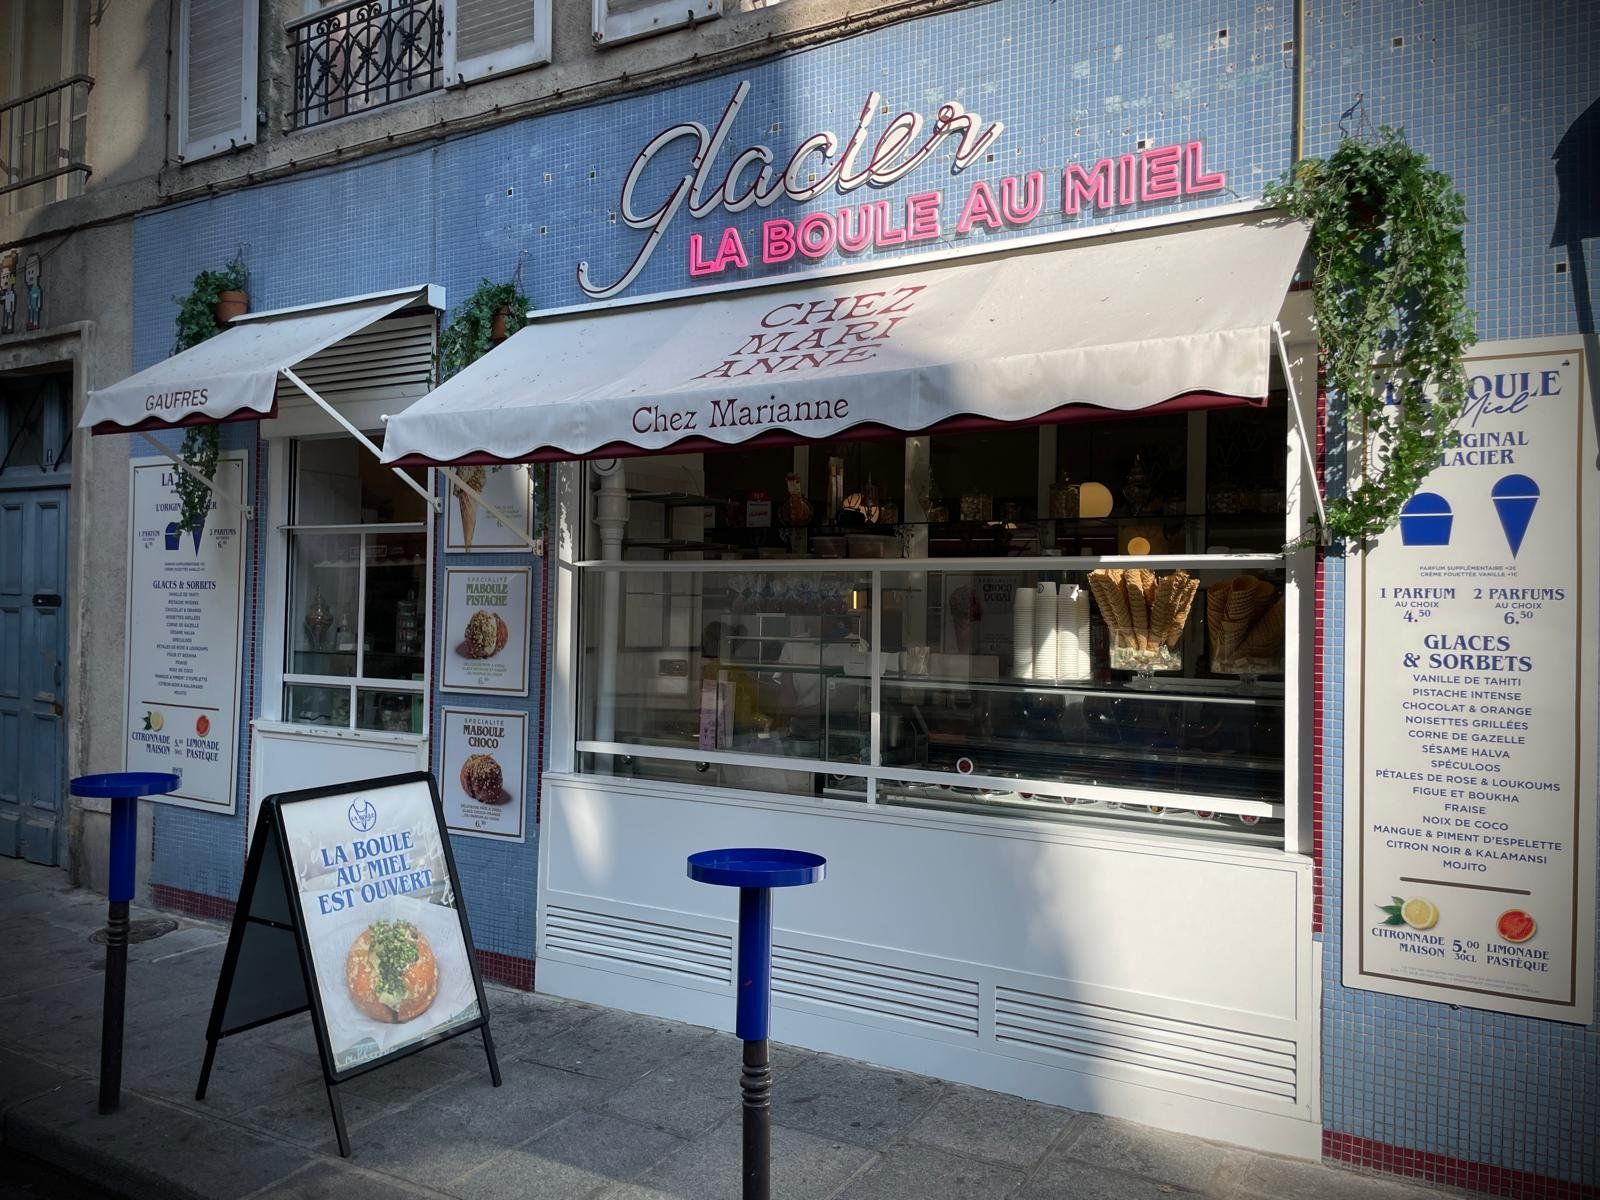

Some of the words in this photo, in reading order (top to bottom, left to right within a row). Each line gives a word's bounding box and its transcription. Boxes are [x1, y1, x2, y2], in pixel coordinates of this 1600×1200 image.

[689, 227, 750, 277] LA
[762, 190, 943, 265] BOULE
[957, 170, 1046, 234] AU
[1064, 140, 1227, 215] MIEL
[759, 285, 928, 329] CHEZ
[730, 316, 909, 356] MARI
[692, 345, 878, 380] ANNE
[1467, 370, 1563, 401] OULE
[145, 388, 209, 411] GAUFRES
[631, 405, 698, 435] Chez
[708, 395, 850, 429] Marianne
[1461, 391, 1529, 428] Miel
[1440, 448, 1516, 467] LACIER
[162, 472, 175, 487] LA
[153, 580, 177, 590] GLACES
[179, 580, 185, 589] &
[186, 580, 217, 590] SORBETS
[466, 583, 509, 594] MABOULE
[465, 595, 508, 606] PISTACHE
[1379, 588, 1386, 599] 1
[1393, 587, 1456, 600] PARFUM
[1473, 588, 1482, 600] 2
[1489, 588, 1565, 601] PARFUMS
[1423, 634, 1511, 652] GLACES
[1402, 653, 1421, 669] &
[1429, 653, 1533, 672] SORBETS
[1412, 674, 1461, 684] VANILLE
[1464, 676, 1480, 685] DE
[1483, 677, 1521, 686] TAHITI
[1412, 688, 1467, 698] PISTACHE
[1471, 691, 1521, 701] INTENSE
[1402, 702, 1465, 713] CHOCOLAT
[1468, 705, 1476, 713] &
[1480, 705, 1532, 716] ORANGE
[463, 724, 505, 738] MABOULE
[1405, 715, 1469, 727] NOISETTES
[1472, 718, 1529, 731] GRILLÉES
[131, 731, 171, 744] CITRONNADE
[186, 737, 220, 751] LIMONADE
[468, 736, 499, 749] CHOCO
[1408, 729, 1449, 740] CORNE
[1452, 732, 1468, 742] DE
[1471, 733, 1526, 745] GAZELLE
[146, 743, 171, 755] MAISON
[1422, 744, 1468, 756] SÉSAME
[1471, 749, 1510, 759] HALVA
[1431, 759, 1501, 773] SPÉCULOOS
[1375, 769, 1424, 782] PÉTALES
[1427, 773, 1442, 783] DE
[1446, 775, 1477, 786] ROSE
[1480, 777, 1489, 786] &
[1492, 778, 1561, 792] LOUKOUMS
[1412, 786, 1447, 797] FIGUE
[1450, 789, 1464, 799] ET
[1468, 791, 1520, 803] BOUKHA
[1444, 804, 1486, 815] FRAISE
[1422, 815, 1451, 826] NOIX
[1455, 818, 1470, 828] DE
[1474, 820, 1509, 831] COCO
[1373, 824, 1422, 837] MANGUE
[1425, 829, 1433, 838] &
[1436, 831, 1480, 843] PIMENT
[1483, 835, 1563, 851] D'ESPELETTE
[321, 845, 348, 868] LA
[352, 831, 414, 861] BOULE
[1386, 840, 1429, 852] CITRON
[1432, 844, 1462, 855] NOIR
[1464, 848, 1472, 857] &
[1476, 849, 1547, 865] KALAMANSI
[337, 863, 362, 887] AU
[367, 854, 411, 879] MIEL
[1443, 860, 1487, 872] MOJITO
[318, 888, 355, 915] EST
[360, 868, 433, 904] OUVERT
[1371, 926, 1445, 946] CITRONNADE
[1399, 942, 1445, 957] MAISON
[1487, 943, 1550, 961] LIMONADE
[1487, 954, 1549, 972] PASTÈQUE
